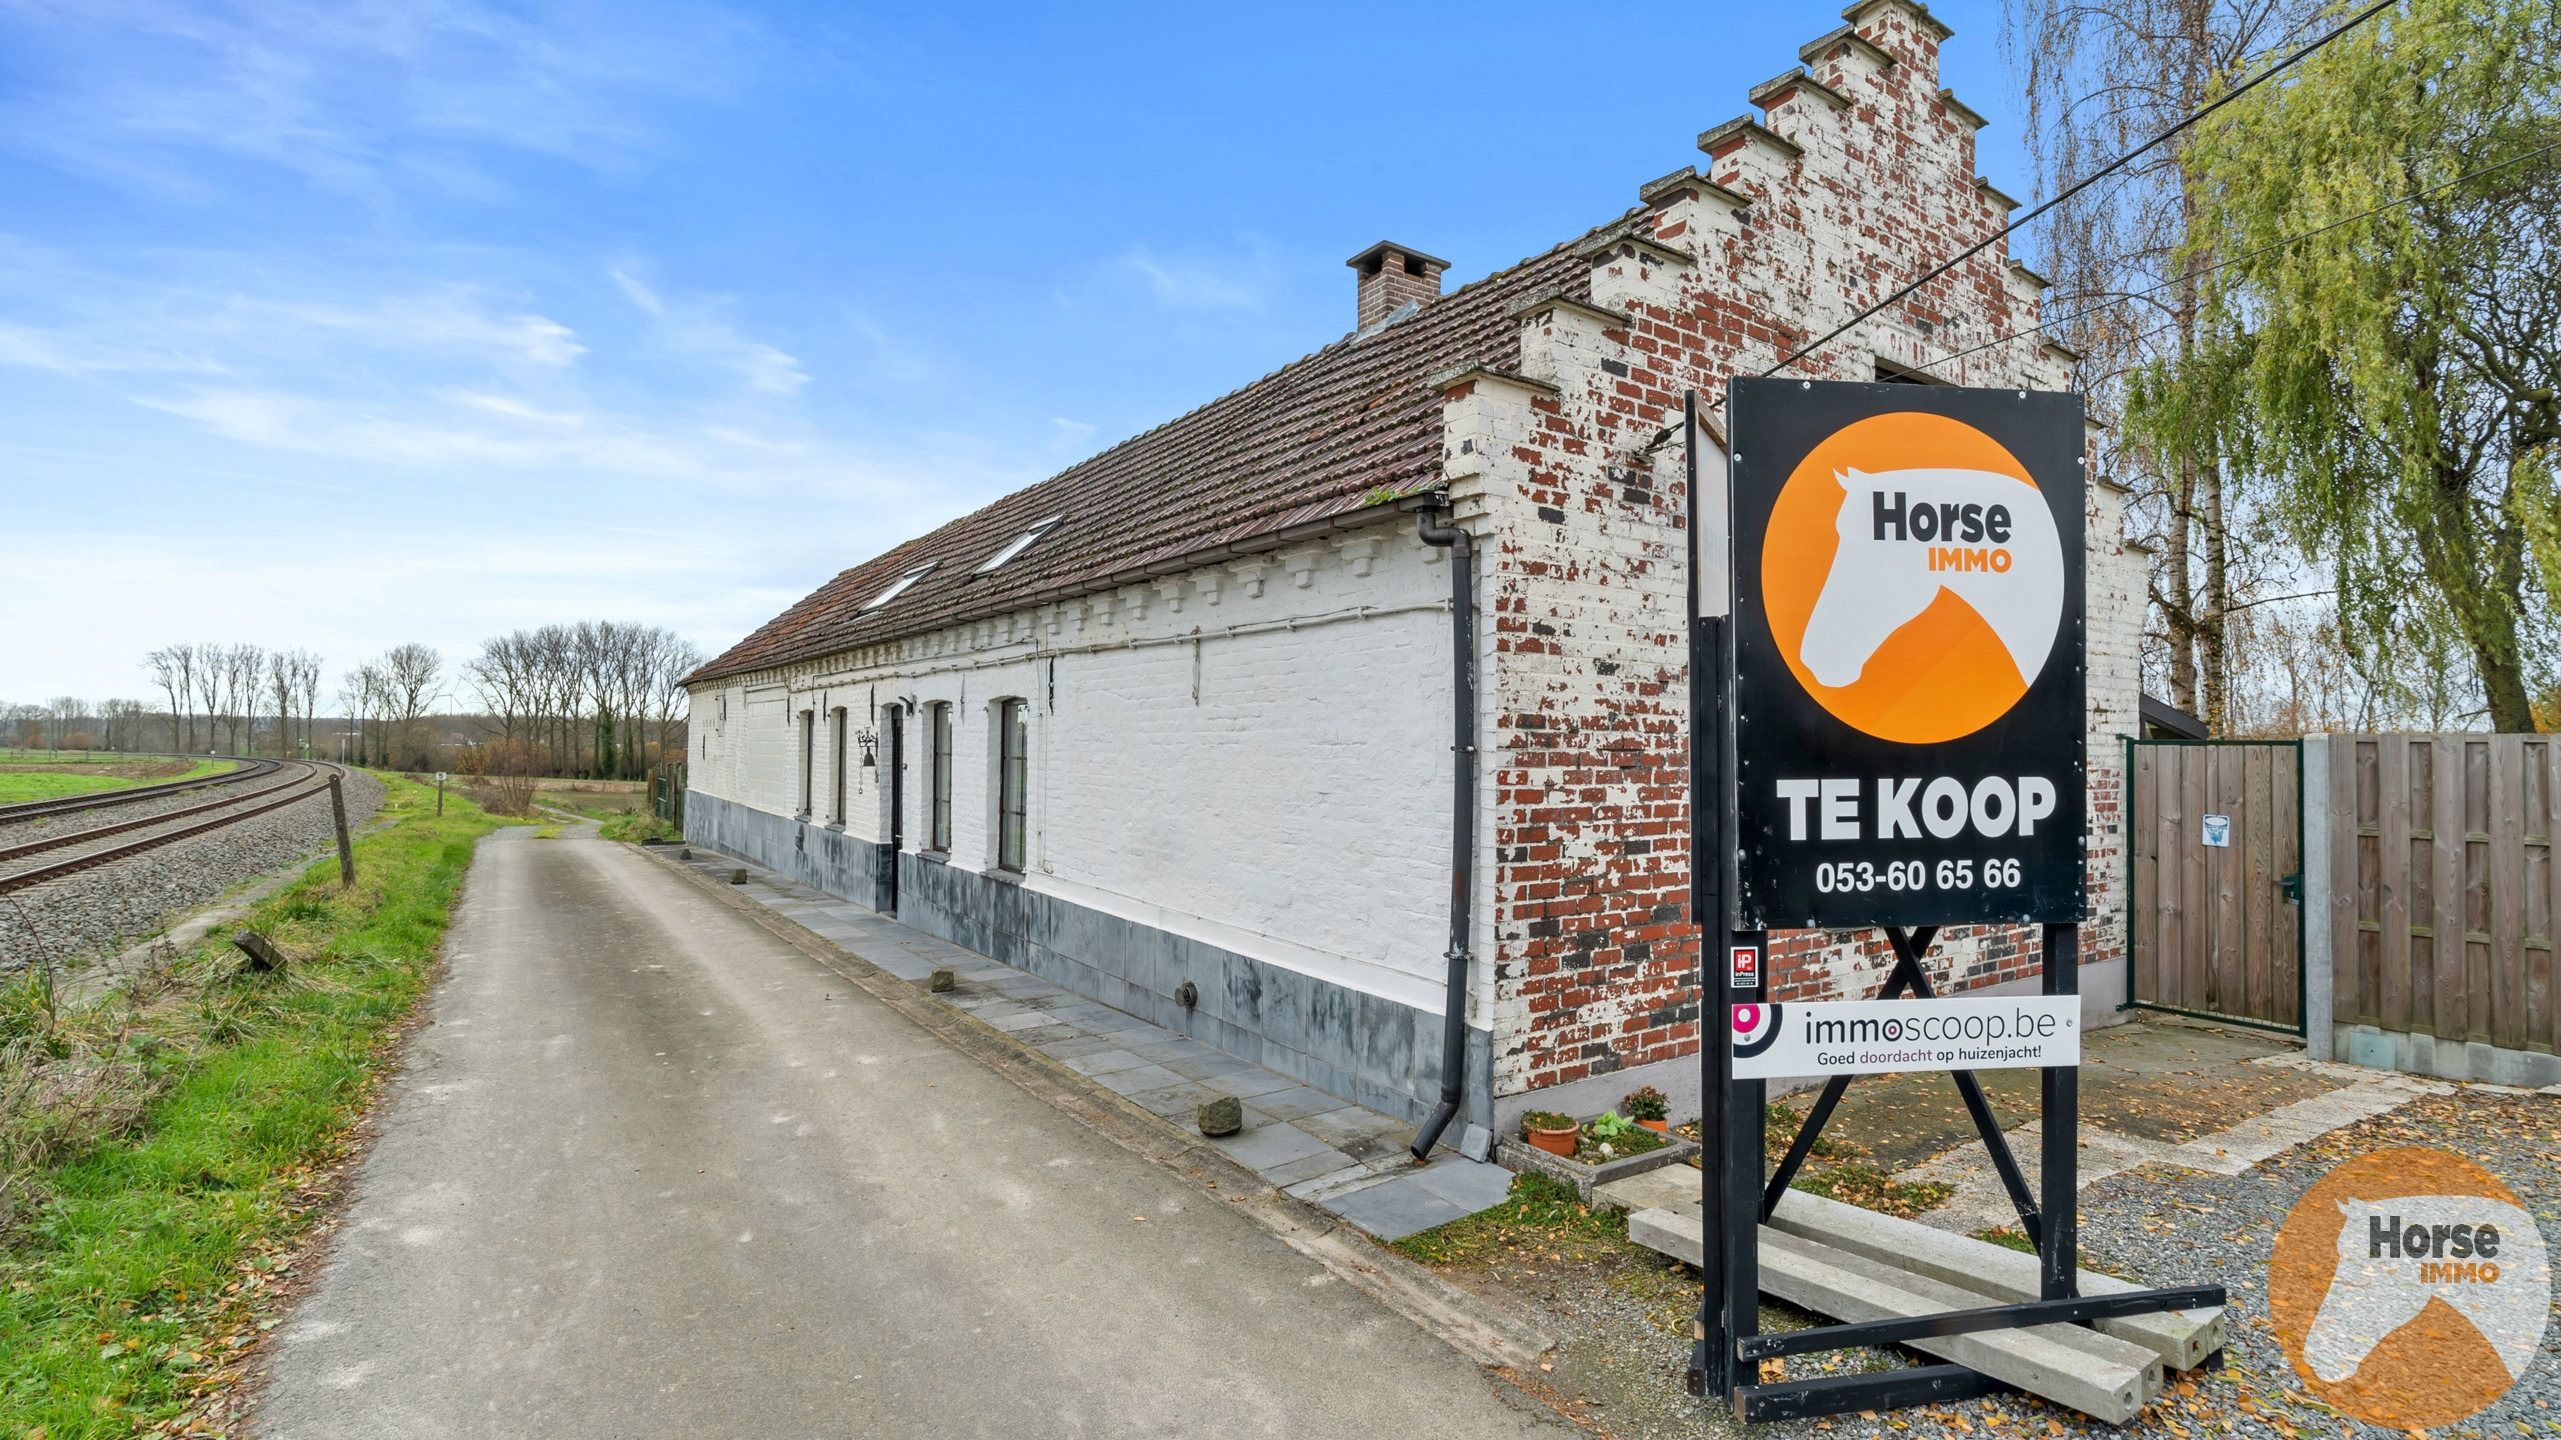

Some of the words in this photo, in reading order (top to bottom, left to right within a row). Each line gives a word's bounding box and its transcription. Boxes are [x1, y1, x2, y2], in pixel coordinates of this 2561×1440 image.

[1873, 491, 2012, 543] Horse
[1928, 547, 2012, 574] IMMO
[1776, 778, 1860, 841] TE
[1878, 776, 2057, 839] KOOP
[1816, 860, 1926, 893] 053-60
[1936, 859, 1974, 890] 65
[1984, 858, 2021, 888] 66
[1806, 1007, 2056, 1046] immoscoop.be
[1817, 1051, 1855, 1066] Goed
[1860, 1049, 1933, 1064] doordacht
[1936, 1050, 1954, 1063] op
[1958, 1045, 2042, 1062] huizenjacht!
